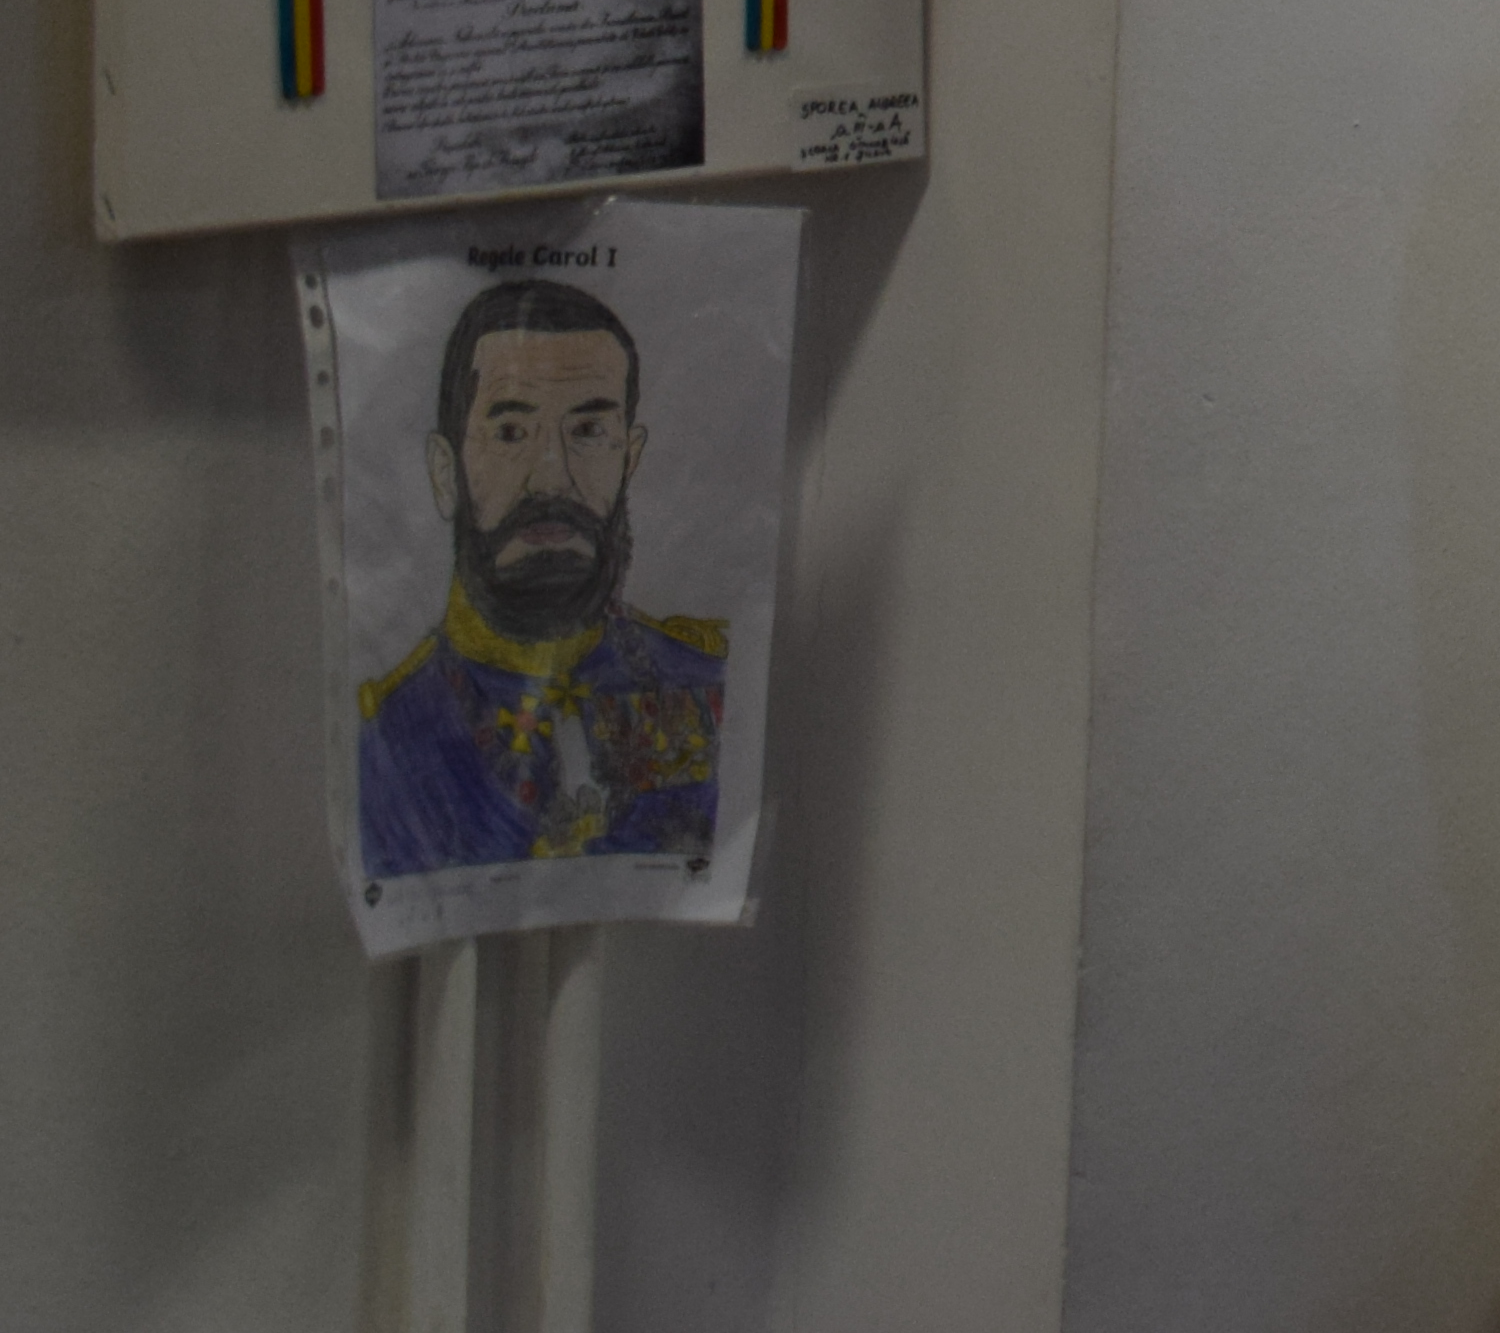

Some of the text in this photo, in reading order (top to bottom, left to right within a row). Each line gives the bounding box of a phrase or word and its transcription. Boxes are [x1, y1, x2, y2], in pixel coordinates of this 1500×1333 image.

[468, 244, 618, 272] Regele Carol I
